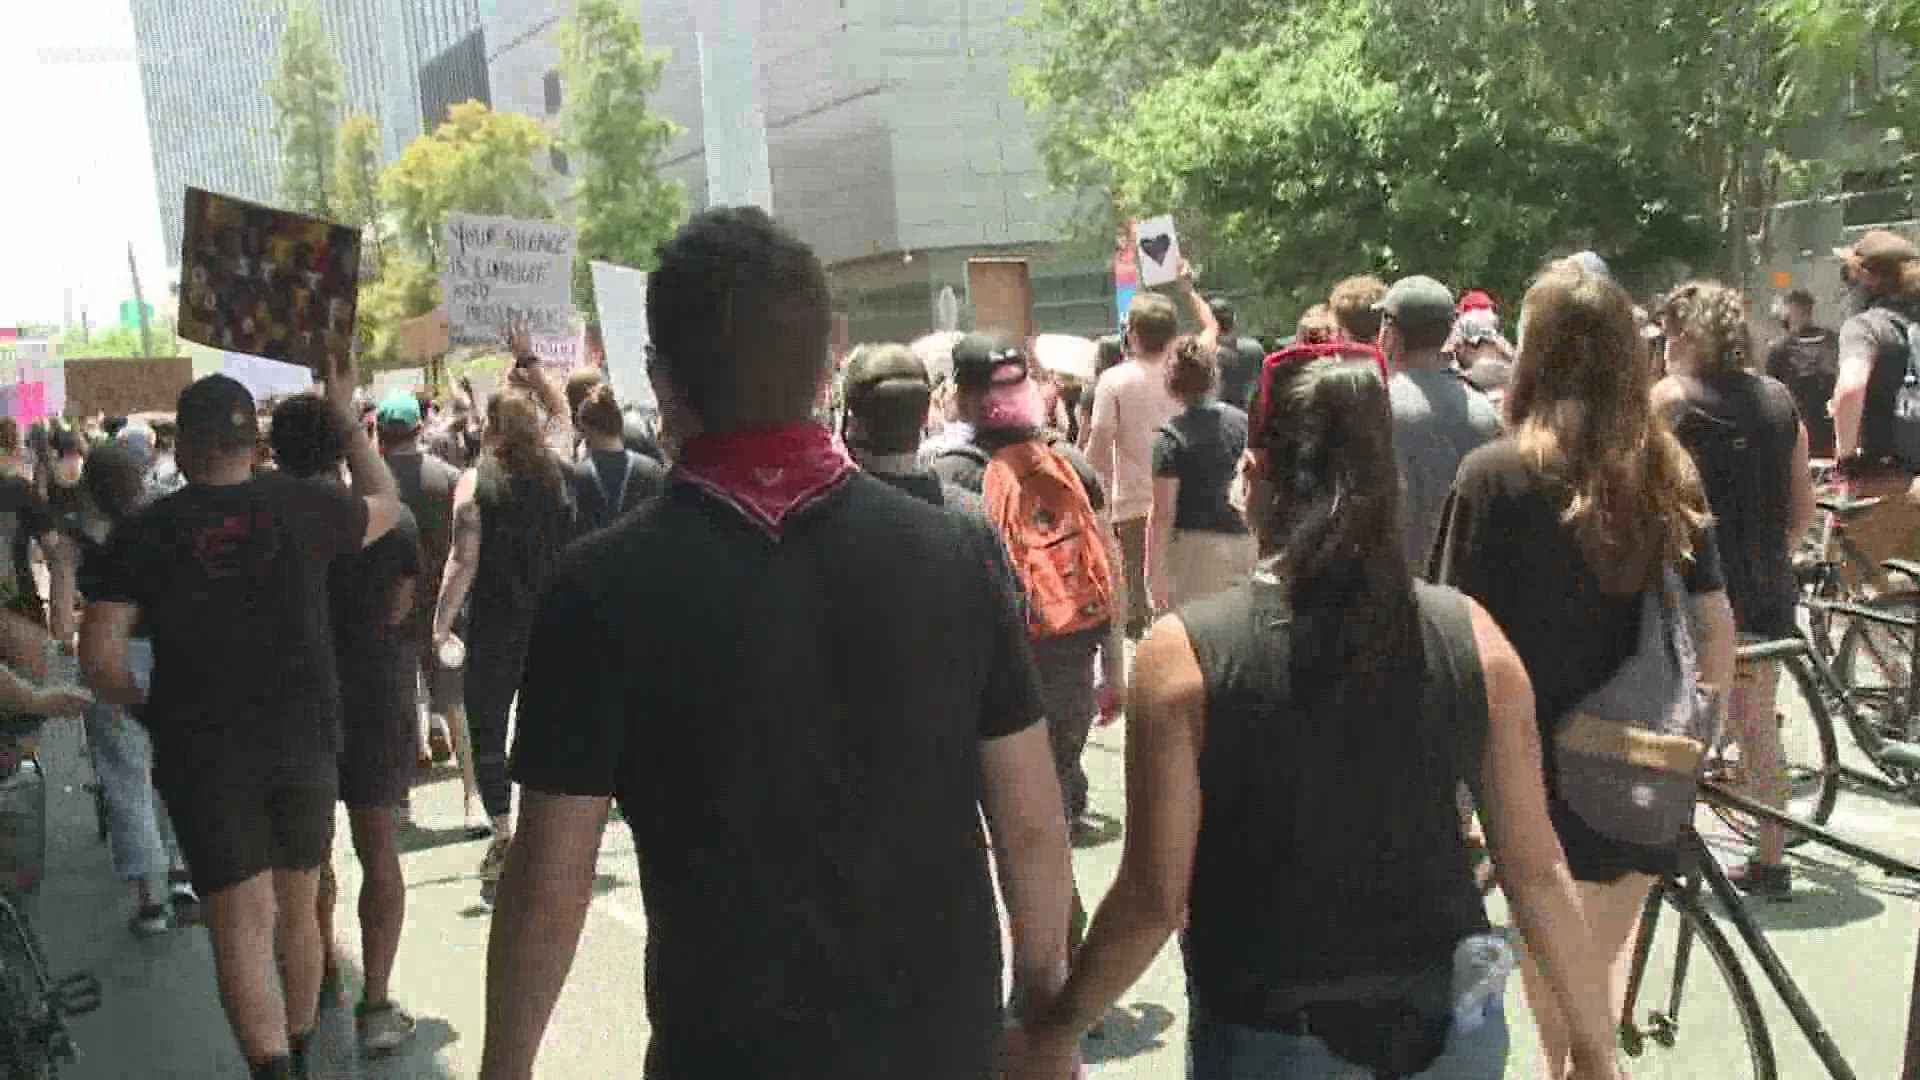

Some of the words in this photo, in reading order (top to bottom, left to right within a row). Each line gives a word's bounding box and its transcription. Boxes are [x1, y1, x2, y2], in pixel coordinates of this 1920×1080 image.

[449, 223, 493, 255] YOUR
[506, 226, 569, 255] SILENCE
[449, 255, 465, 273] IS
